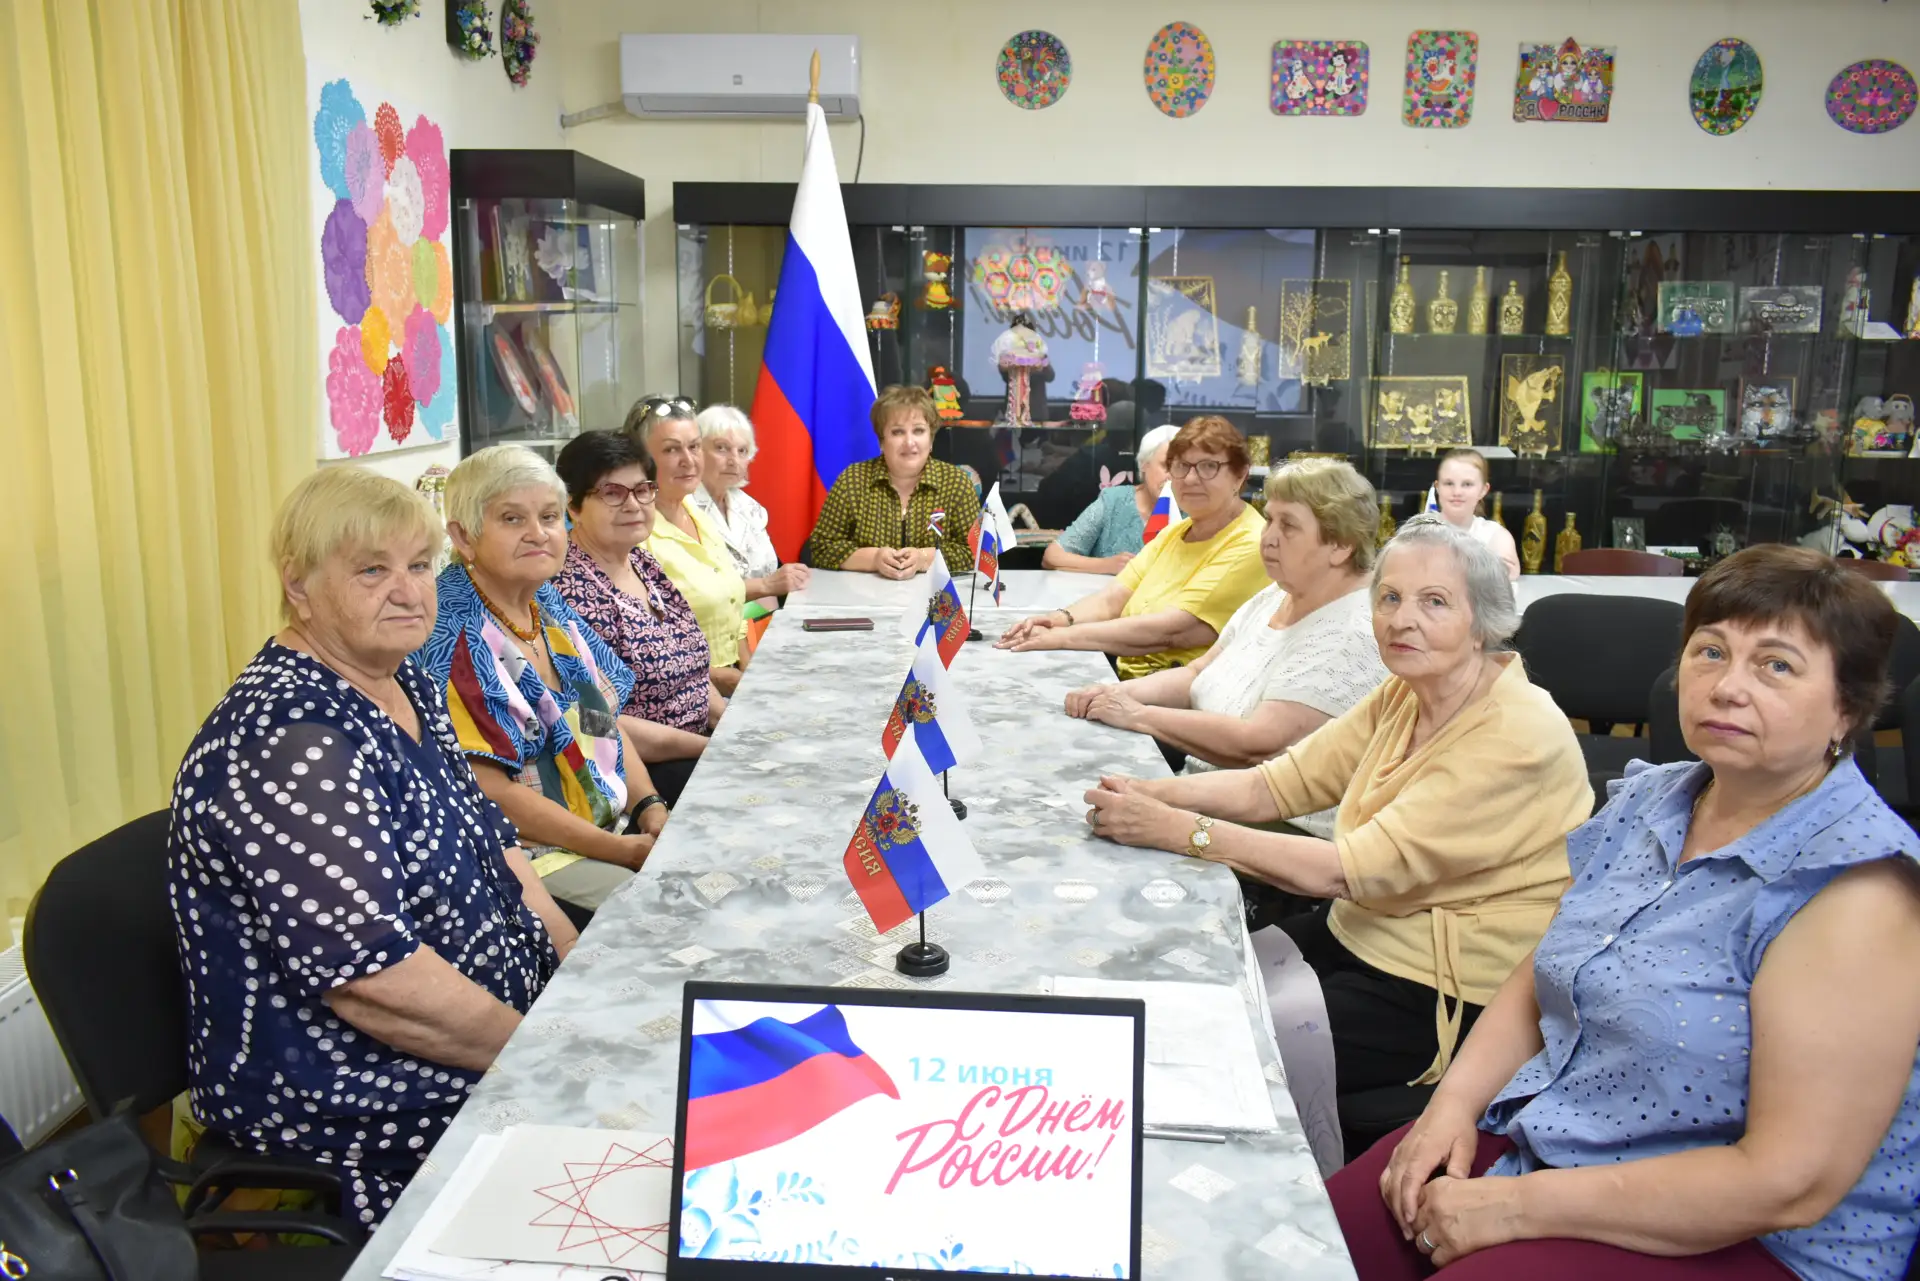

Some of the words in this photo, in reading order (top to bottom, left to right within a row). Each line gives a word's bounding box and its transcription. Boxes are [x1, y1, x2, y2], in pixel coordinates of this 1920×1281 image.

[1526, 103, 1535, 116] Я
[908, 1057, 947, 1083] 12
[957, 1064, 1054, 1087] июня
[958, 1085, 1002, 1142] С
[998, 1085, 1126, 1138] Днём
[884, 1119, 1116, 1195] России!
